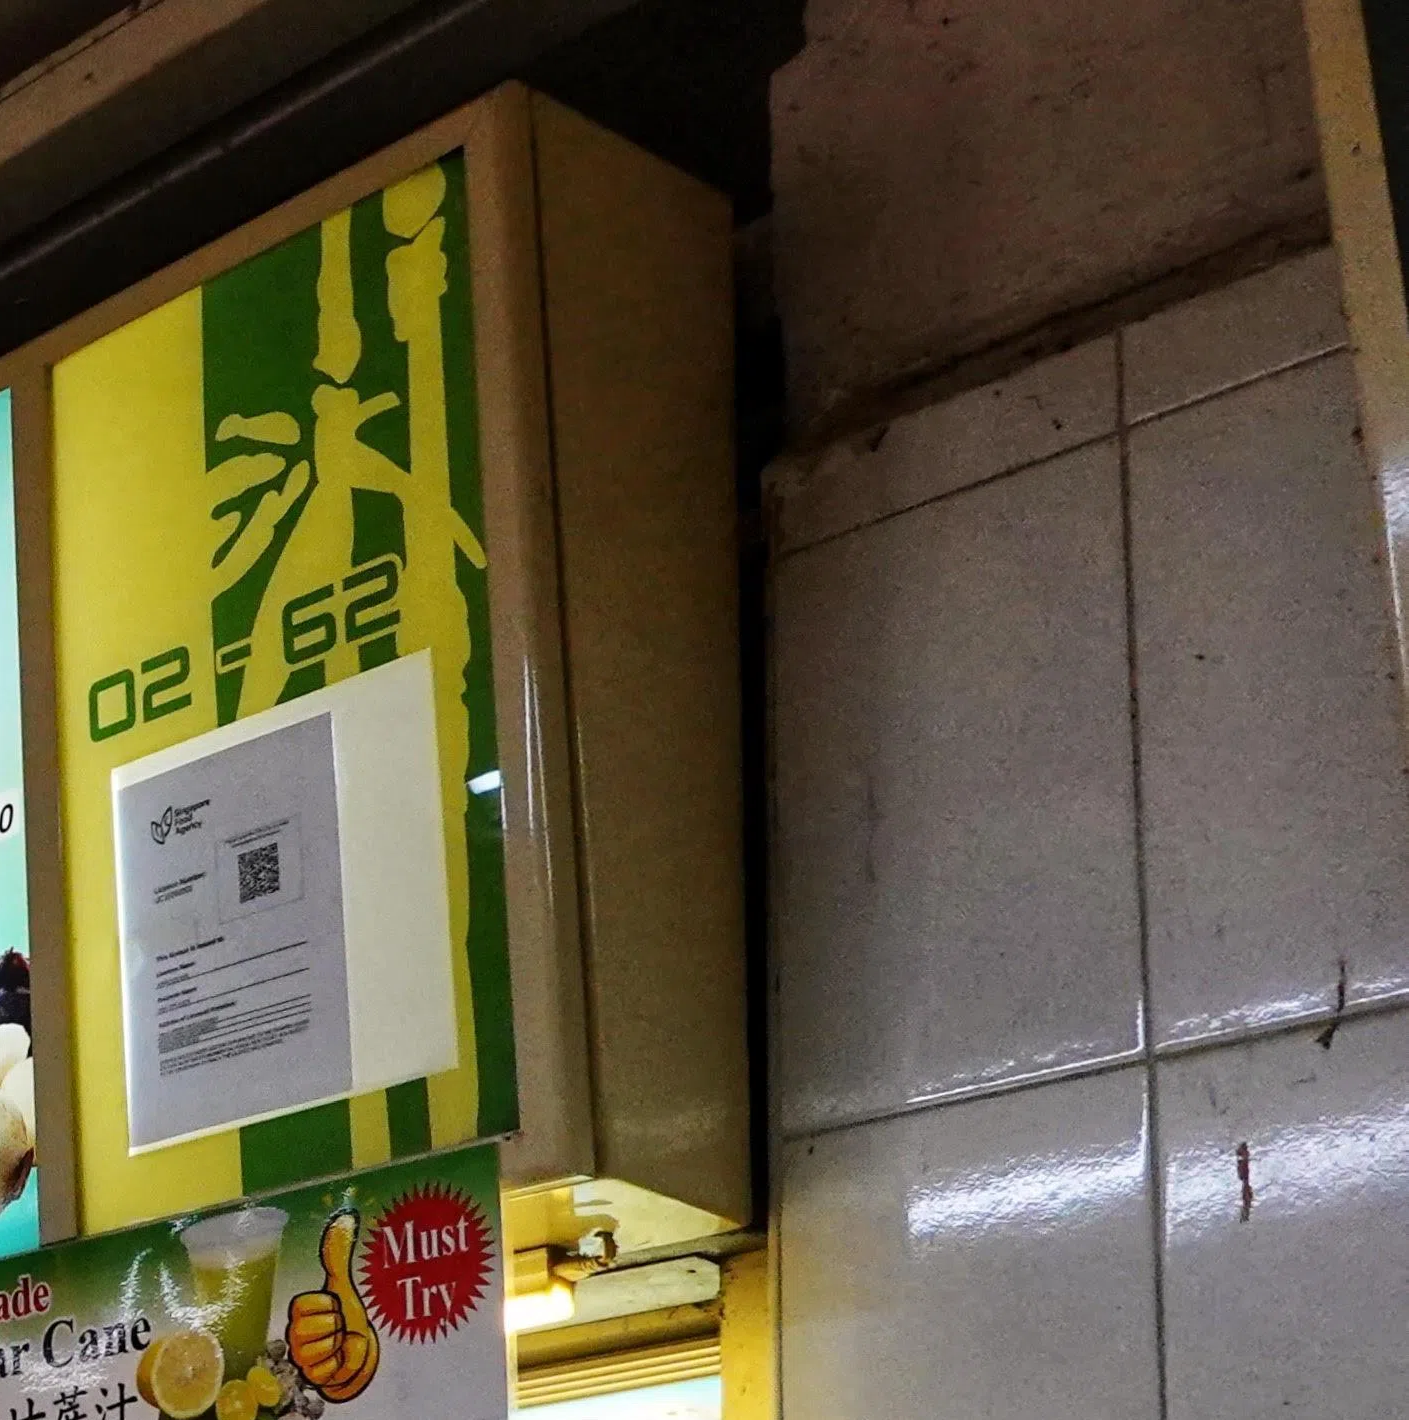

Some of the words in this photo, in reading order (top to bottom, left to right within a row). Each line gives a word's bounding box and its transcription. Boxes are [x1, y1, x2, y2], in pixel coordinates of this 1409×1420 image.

[382, 1214, 470, 1272] Must
[396, 1273, 458, 1325] Try
[42, 1313, 153, 1371] Cane
